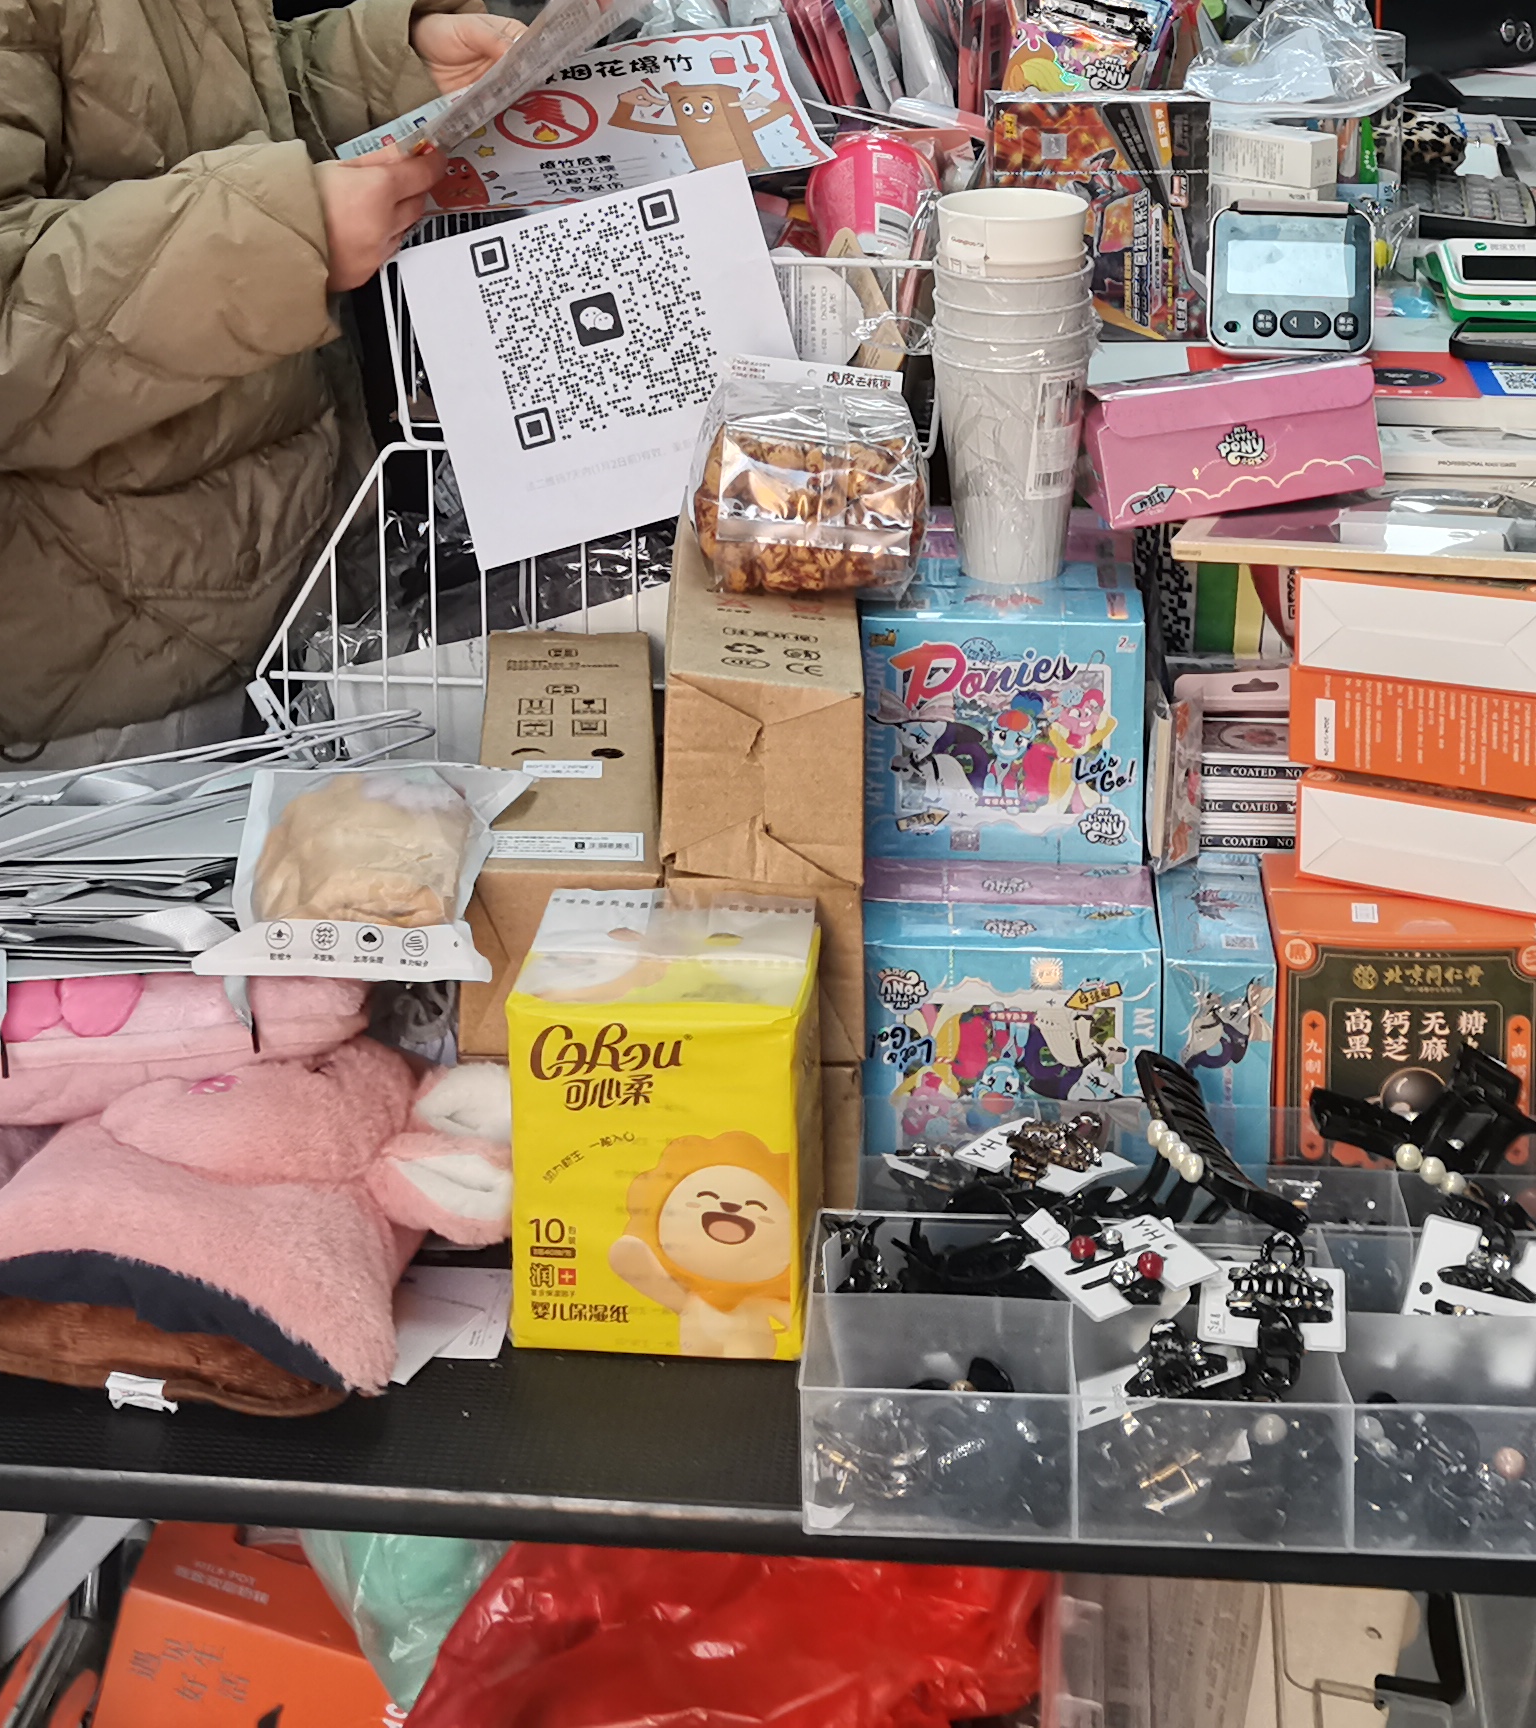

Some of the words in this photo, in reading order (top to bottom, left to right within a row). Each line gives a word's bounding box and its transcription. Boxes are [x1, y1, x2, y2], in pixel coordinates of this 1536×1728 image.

[1219, 438, 1267, 458] PONY
[888, 640, 1078, 710] Ponies
[1074, 750, 1119, 782] Let's
[1099, 757, 1136, 793] Go!
[1231, 766, 1277, 778] COATED
[1205, 800, 1223, 812] TIC
[1240, 801, 1278, 812] COATED
[1079, 820, 1125, 839] PONY
[1222, 836, 1269, 847] COATED
[1277, 837, 1294, 848] NO
[1344, 1006, 1487, 1035] 高钙无糖
[1344, 1034, 1472, 1061] 黑芝麻
[563, 1074, 654, 1111] 可心柔
[529, 1218, 565, 1243] 10
[529, 1301, 630, 1324] 婴儿保湿纸
